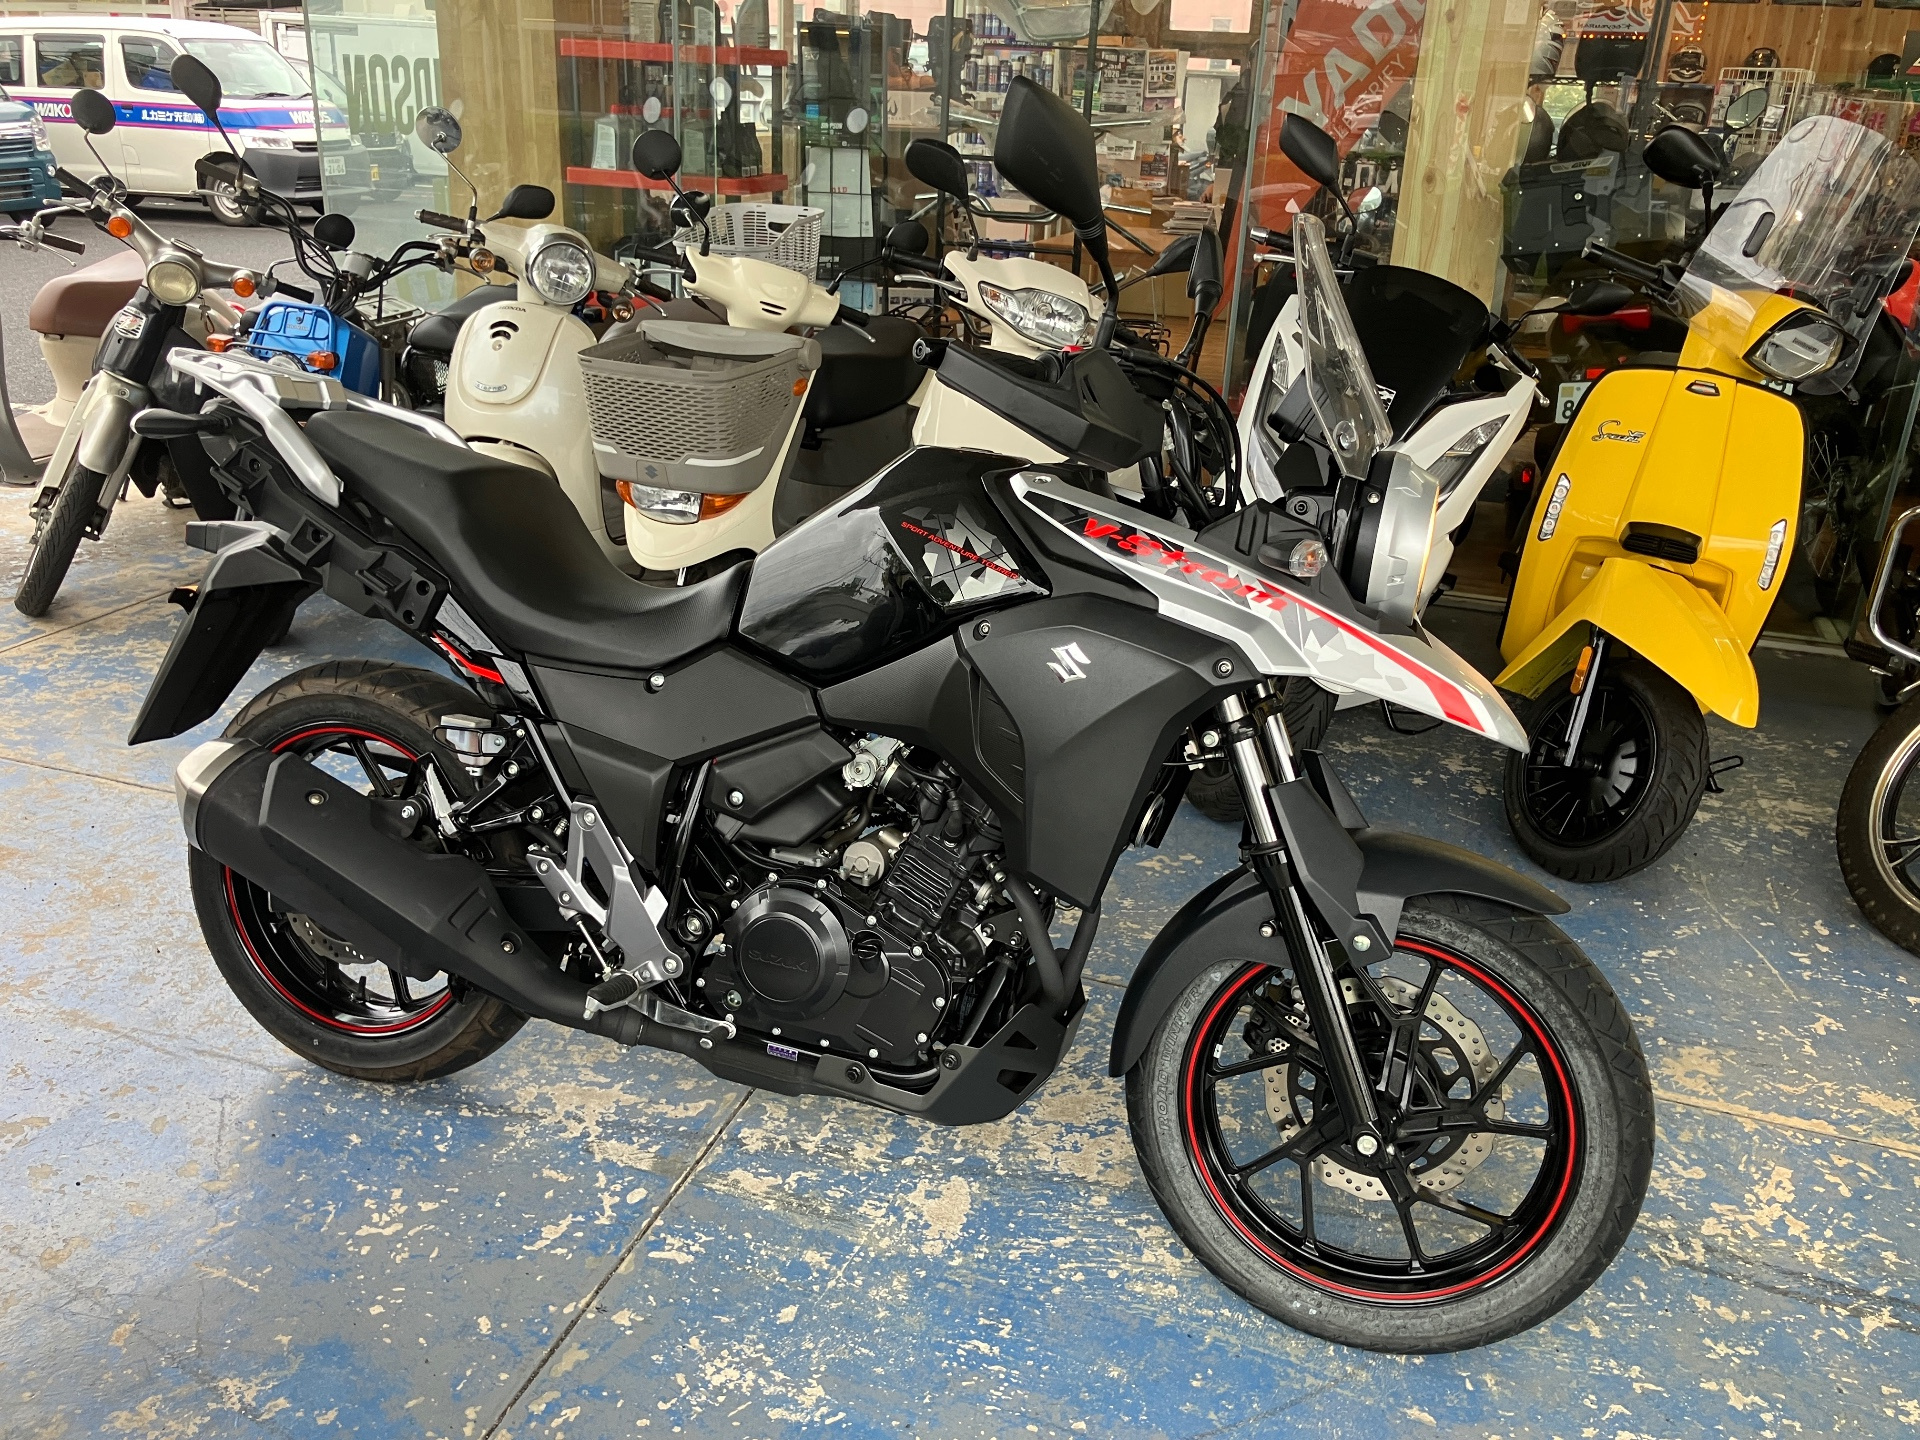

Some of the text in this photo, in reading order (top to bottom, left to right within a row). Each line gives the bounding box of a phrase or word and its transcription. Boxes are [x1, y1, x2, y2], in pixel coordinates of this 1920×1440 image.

[499, 305, 527, 313] HONDA
[901, 520, 1020, 580] SPORT ADVENTURE TOURER
[1083, 517, 1288, 612] V-Strom
[1157, 985, 1200, 1132] ROAD WINNER
